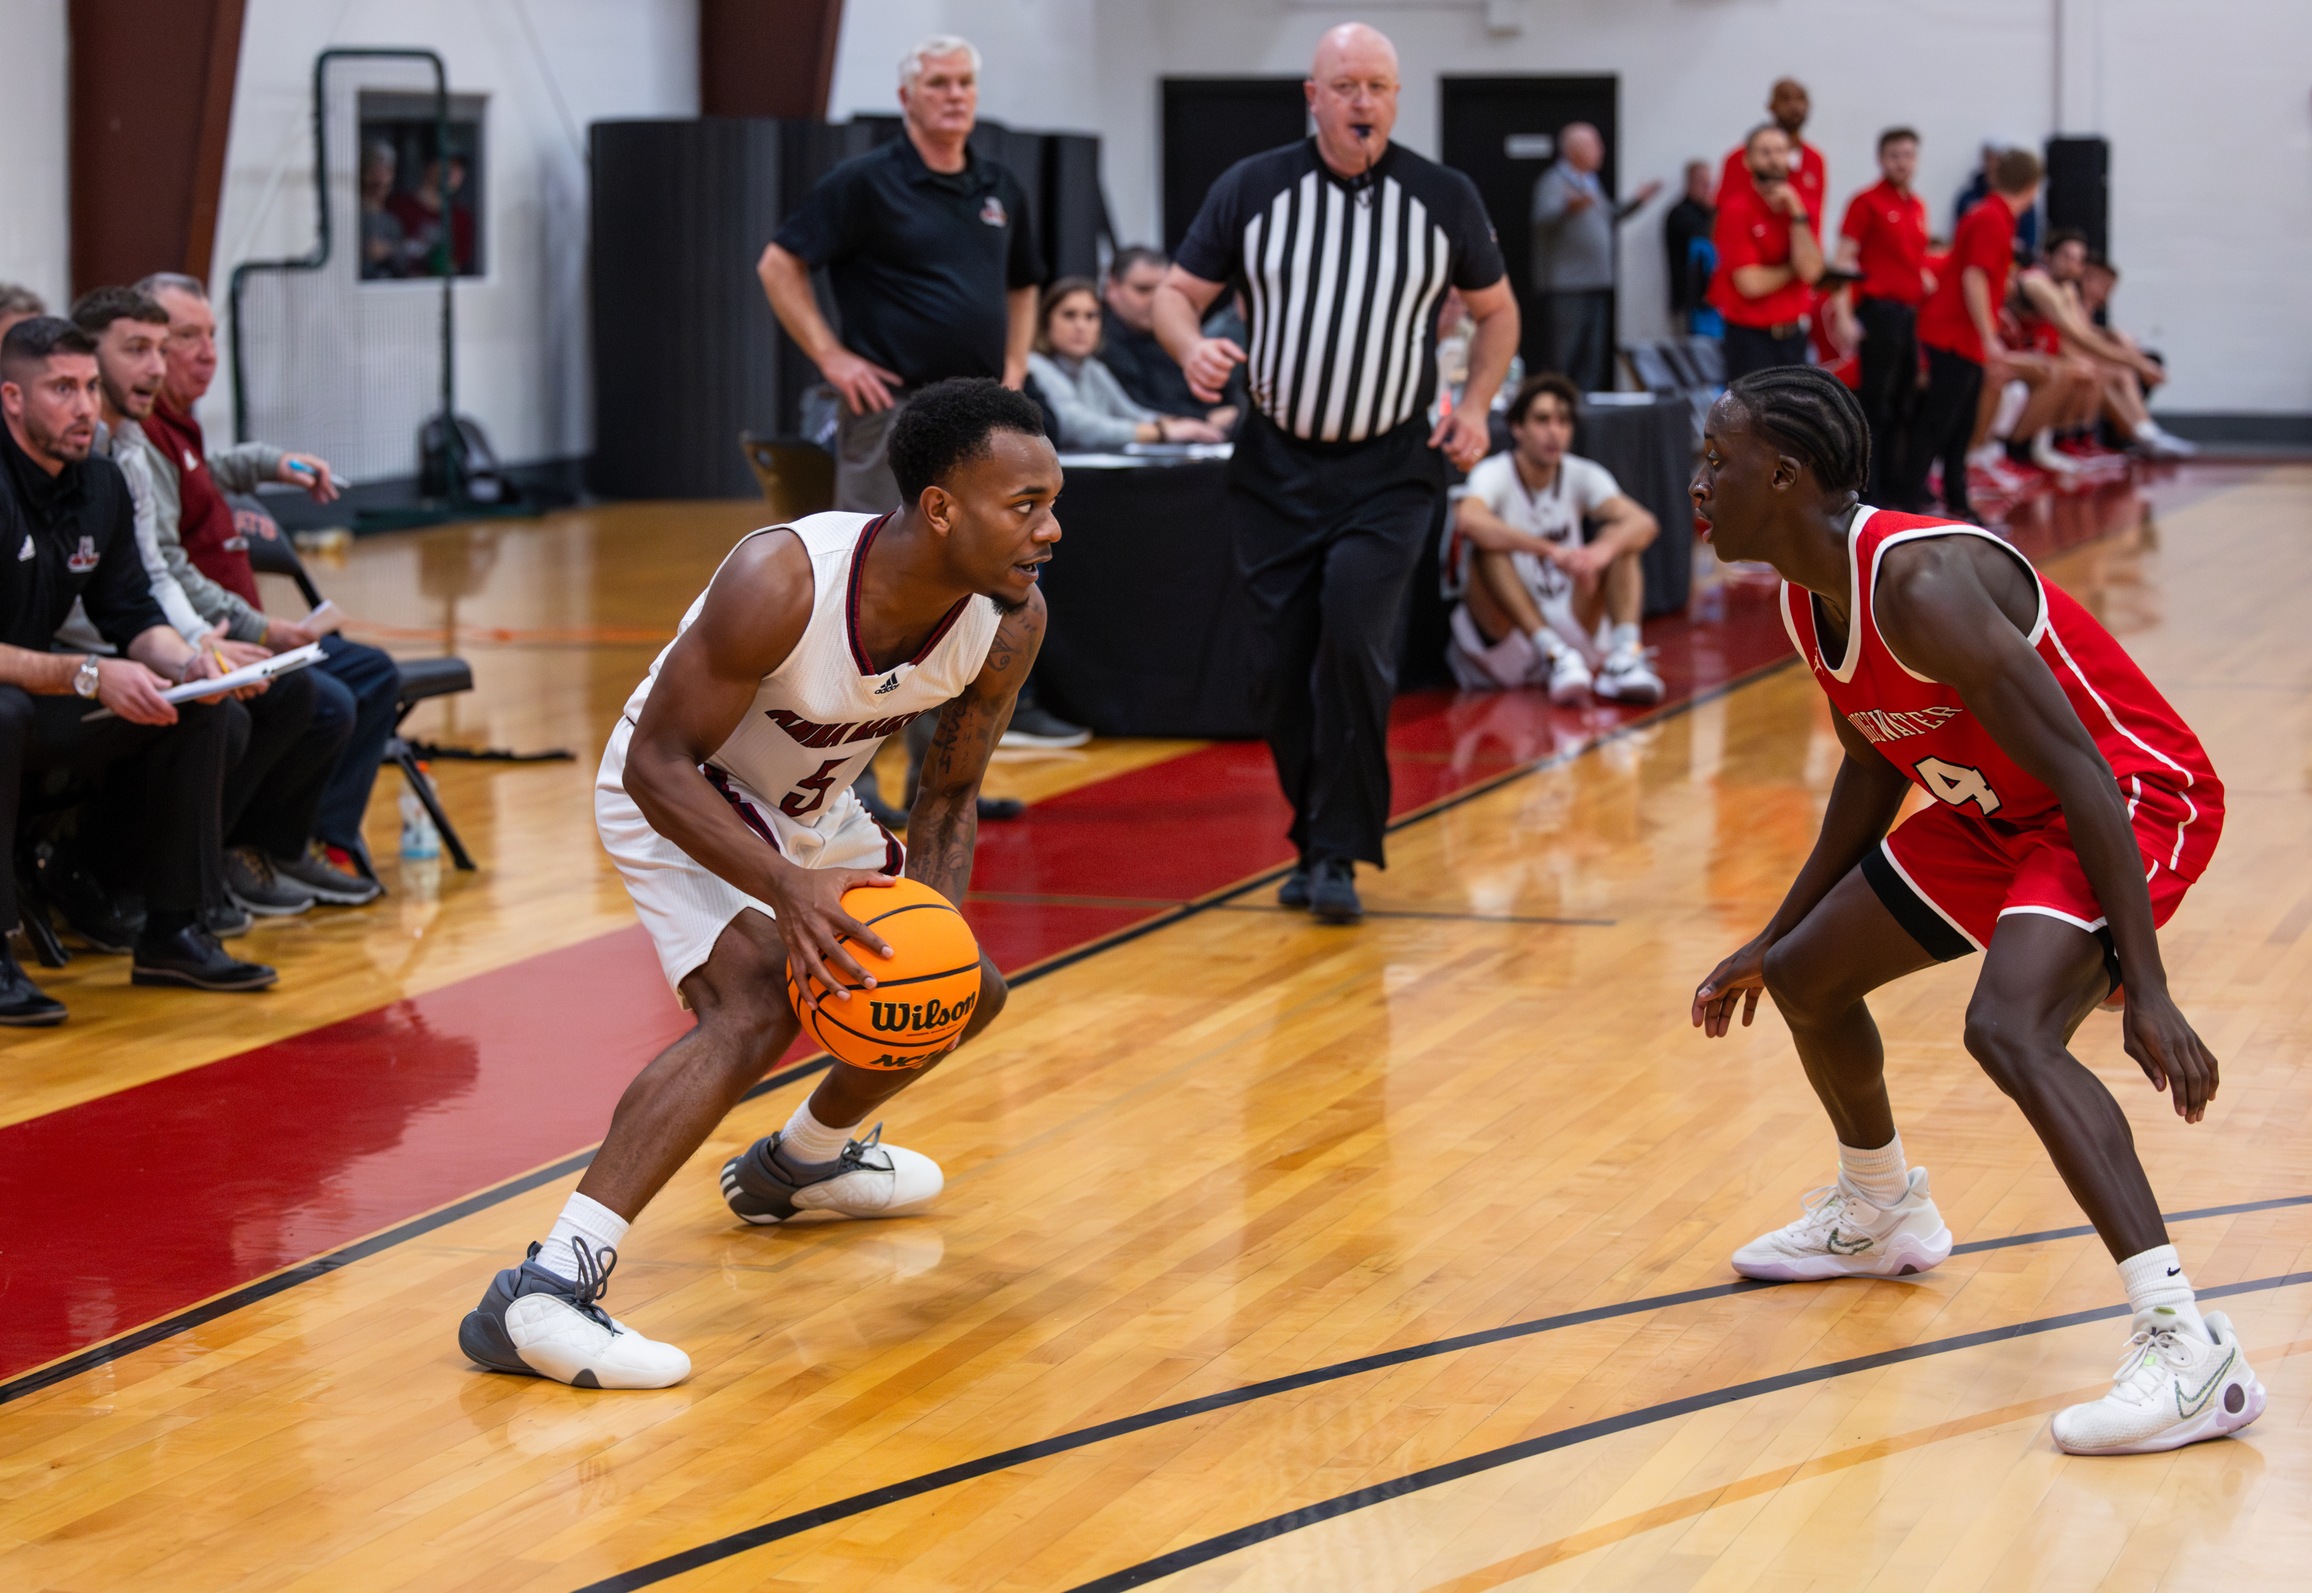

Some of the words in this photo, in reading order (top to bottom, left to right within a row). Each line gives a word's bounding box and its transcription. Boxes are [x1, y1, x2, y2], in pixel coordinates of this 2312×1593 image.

[779, 755, 854, 817] 5
[1912, 755, 2003, 817] 4
[870, 991, 976, 1032] Wilson
